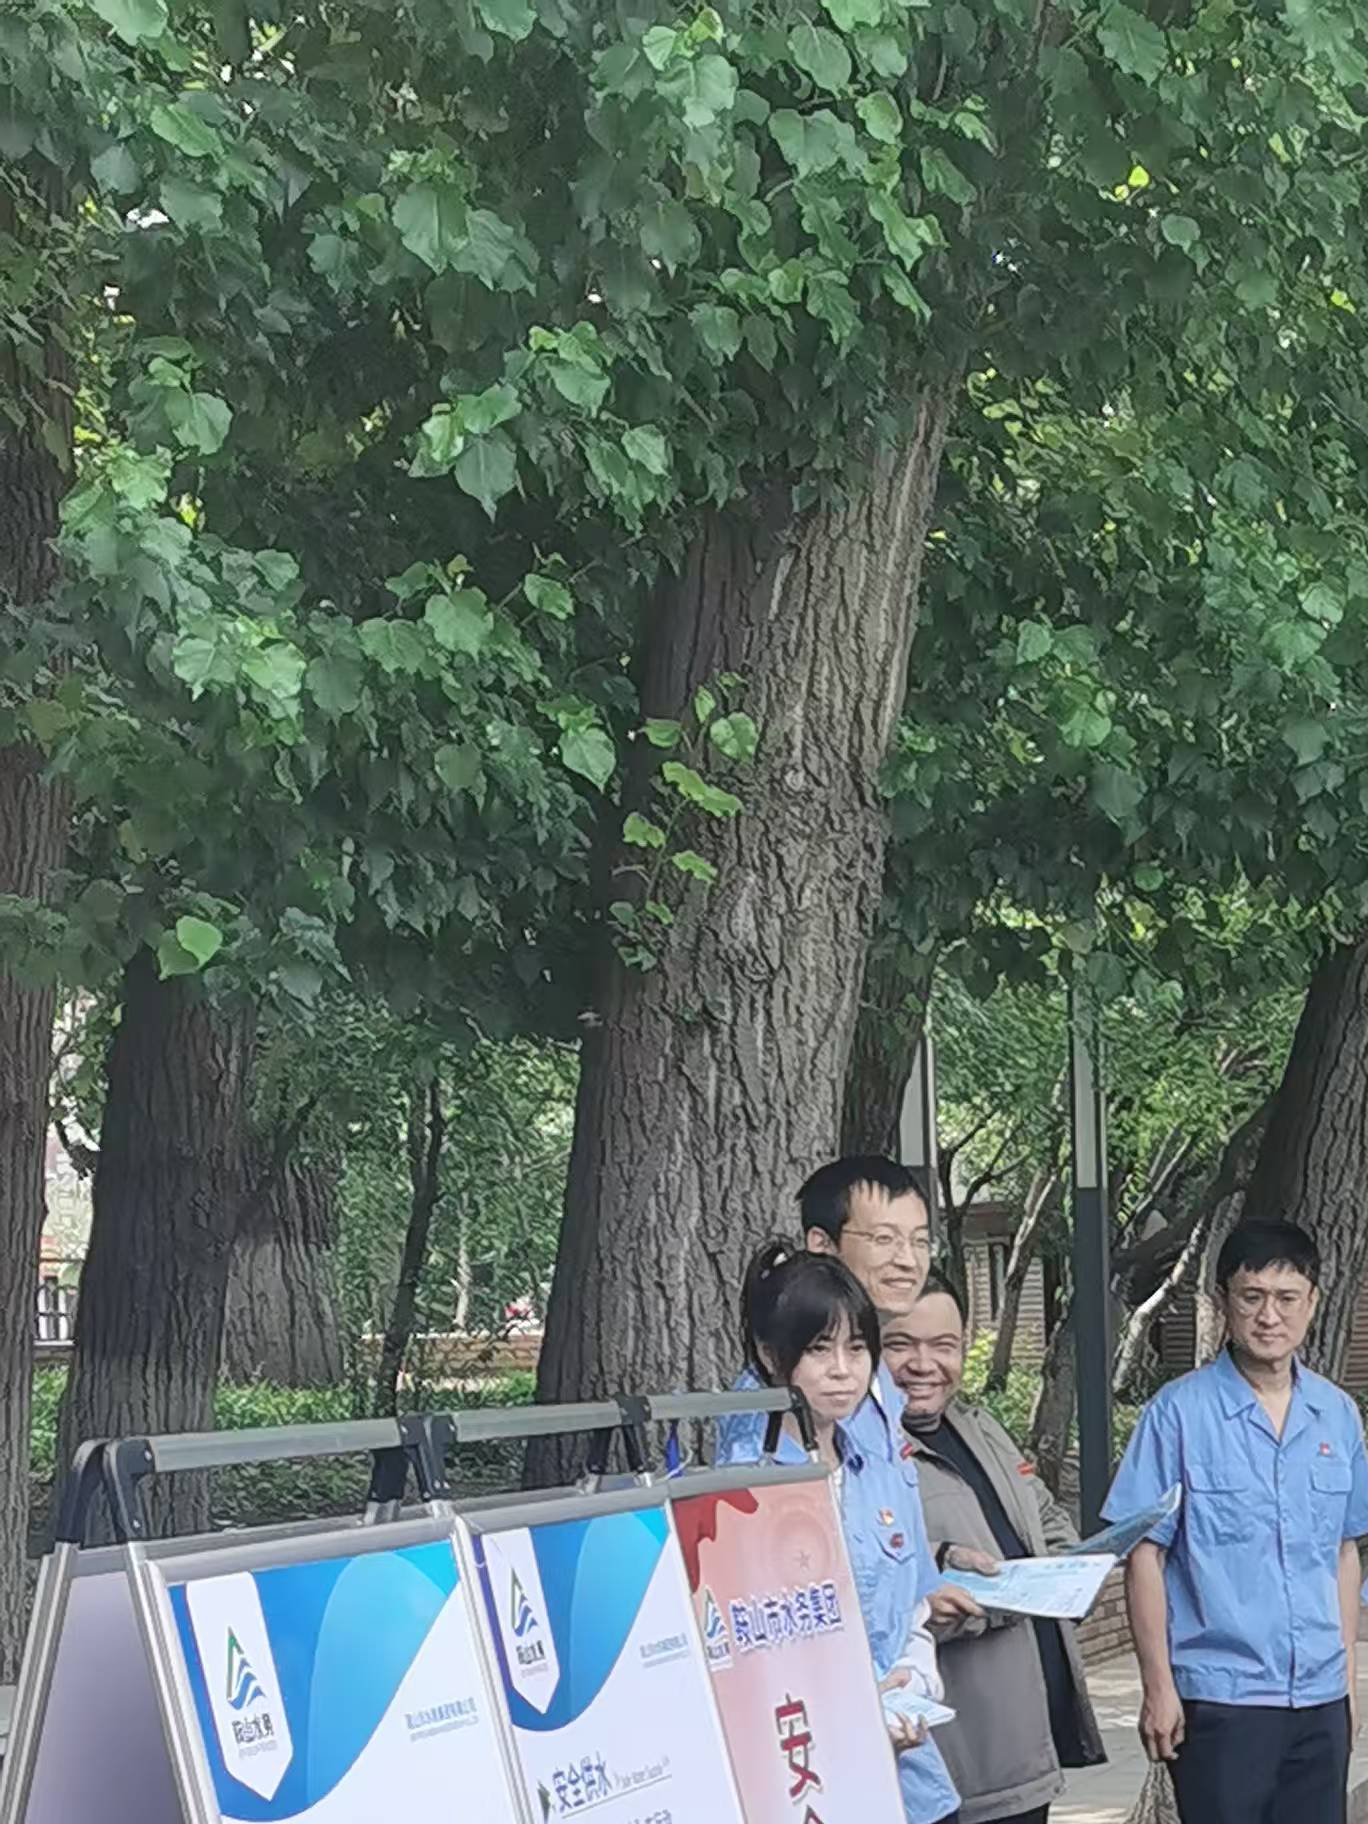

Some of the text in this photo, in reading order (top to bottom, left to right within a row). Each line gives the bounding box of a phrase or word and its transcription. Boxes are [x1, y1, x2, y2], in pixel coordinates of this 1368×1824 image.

[731, 1582, 843, 1649] 鞍山市水务集团
